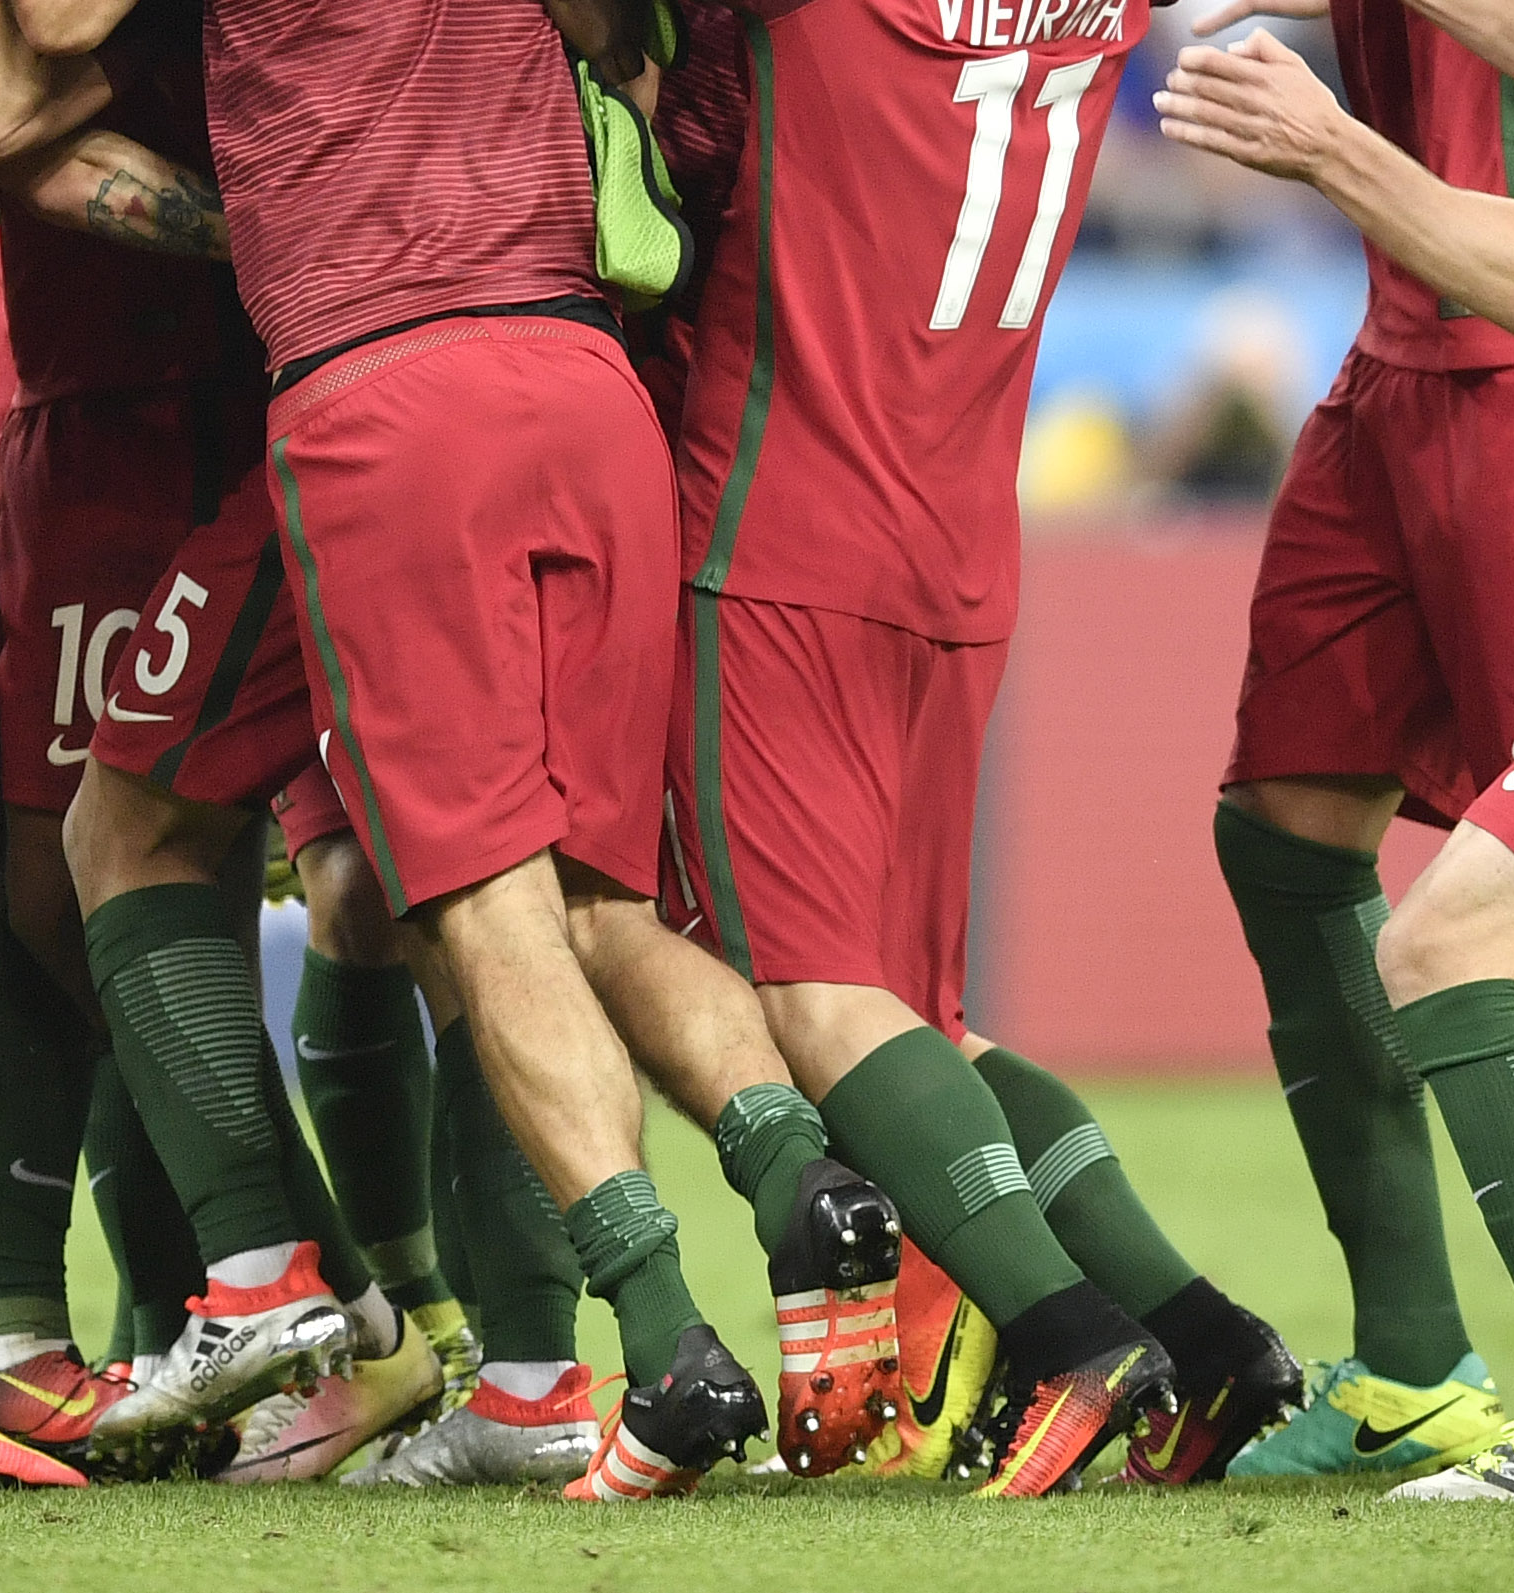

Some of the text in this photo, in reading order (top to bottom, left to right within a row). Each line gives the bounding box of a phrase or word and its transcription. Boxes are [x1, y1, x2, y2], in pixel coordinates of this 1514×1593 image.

[928, 49, 1104, 330] 11
[50, 602, 142, 727] 10
[134, 571, 210, 695] 5
[190, 1324, 257, 1394] adidas
